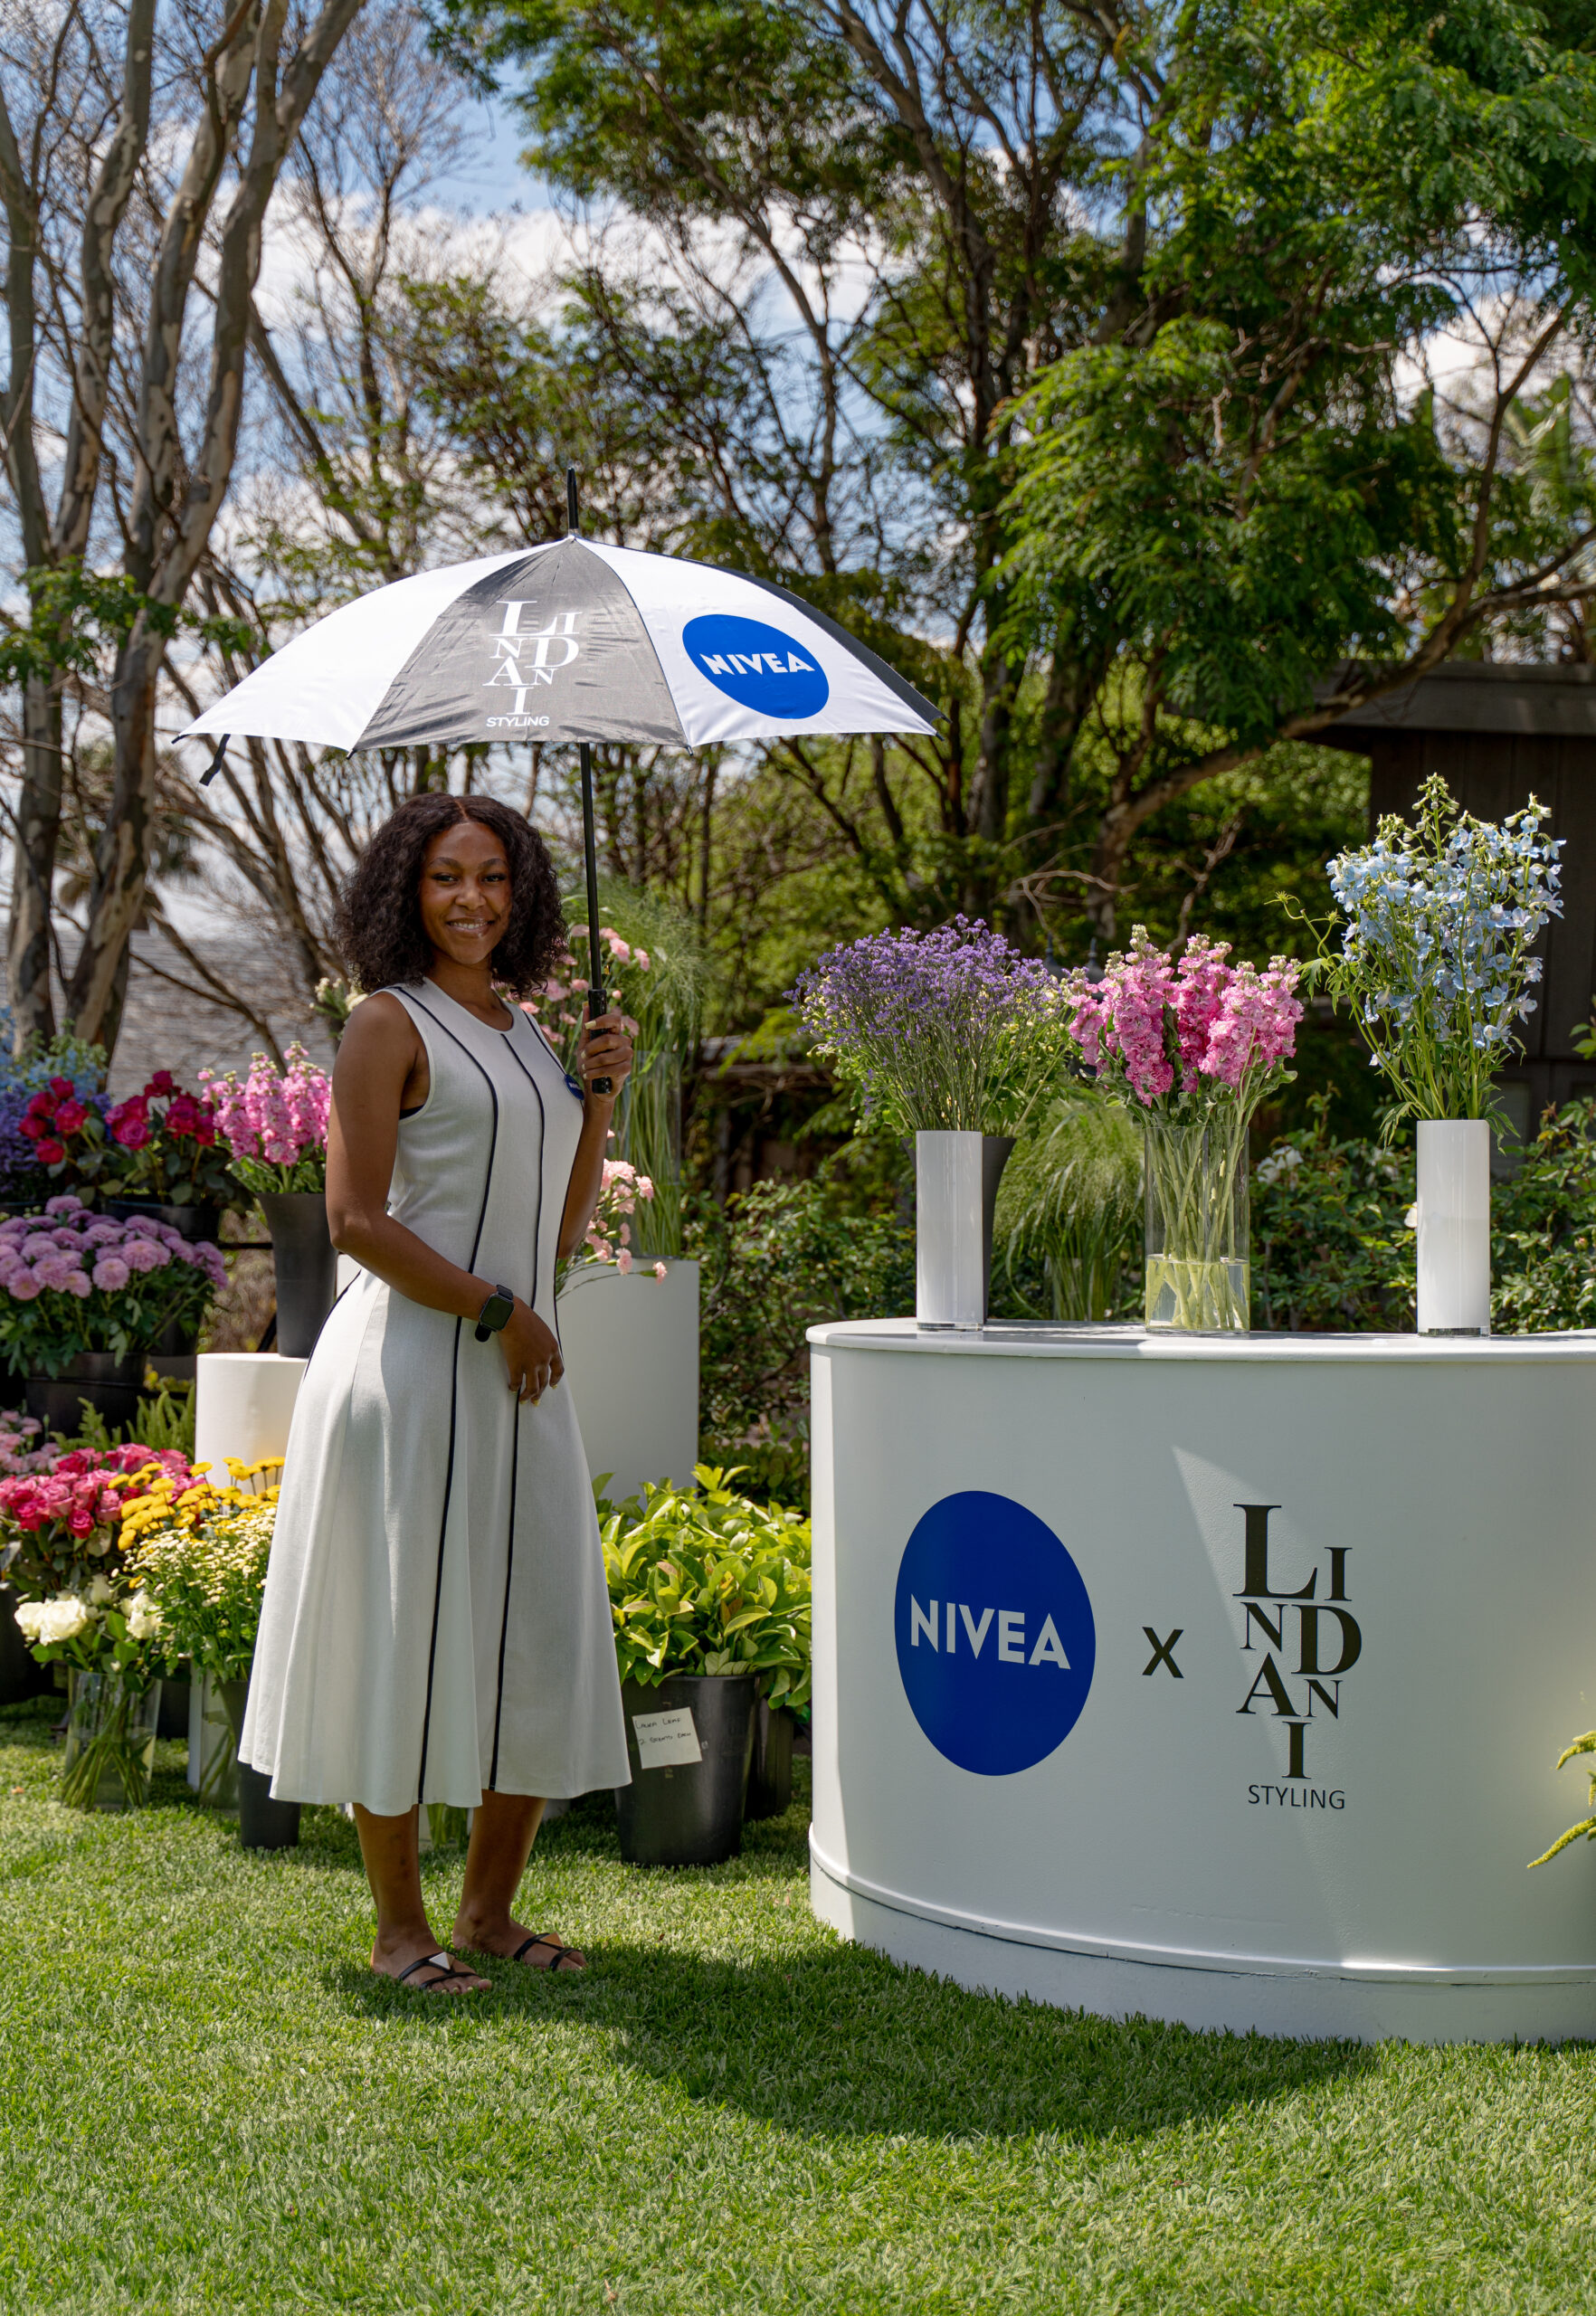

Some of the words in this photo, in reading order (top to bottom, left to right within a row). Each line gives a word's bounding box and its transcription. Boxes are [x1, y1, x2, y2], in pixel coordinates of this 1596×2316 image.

[698, 650, 815, 676] NIVEA
[486, 716, 550, 727] STYLING
[910, 1592, 1071, 1670] NIVEA
[1248, 1784, 1345, 1810] STYLING
